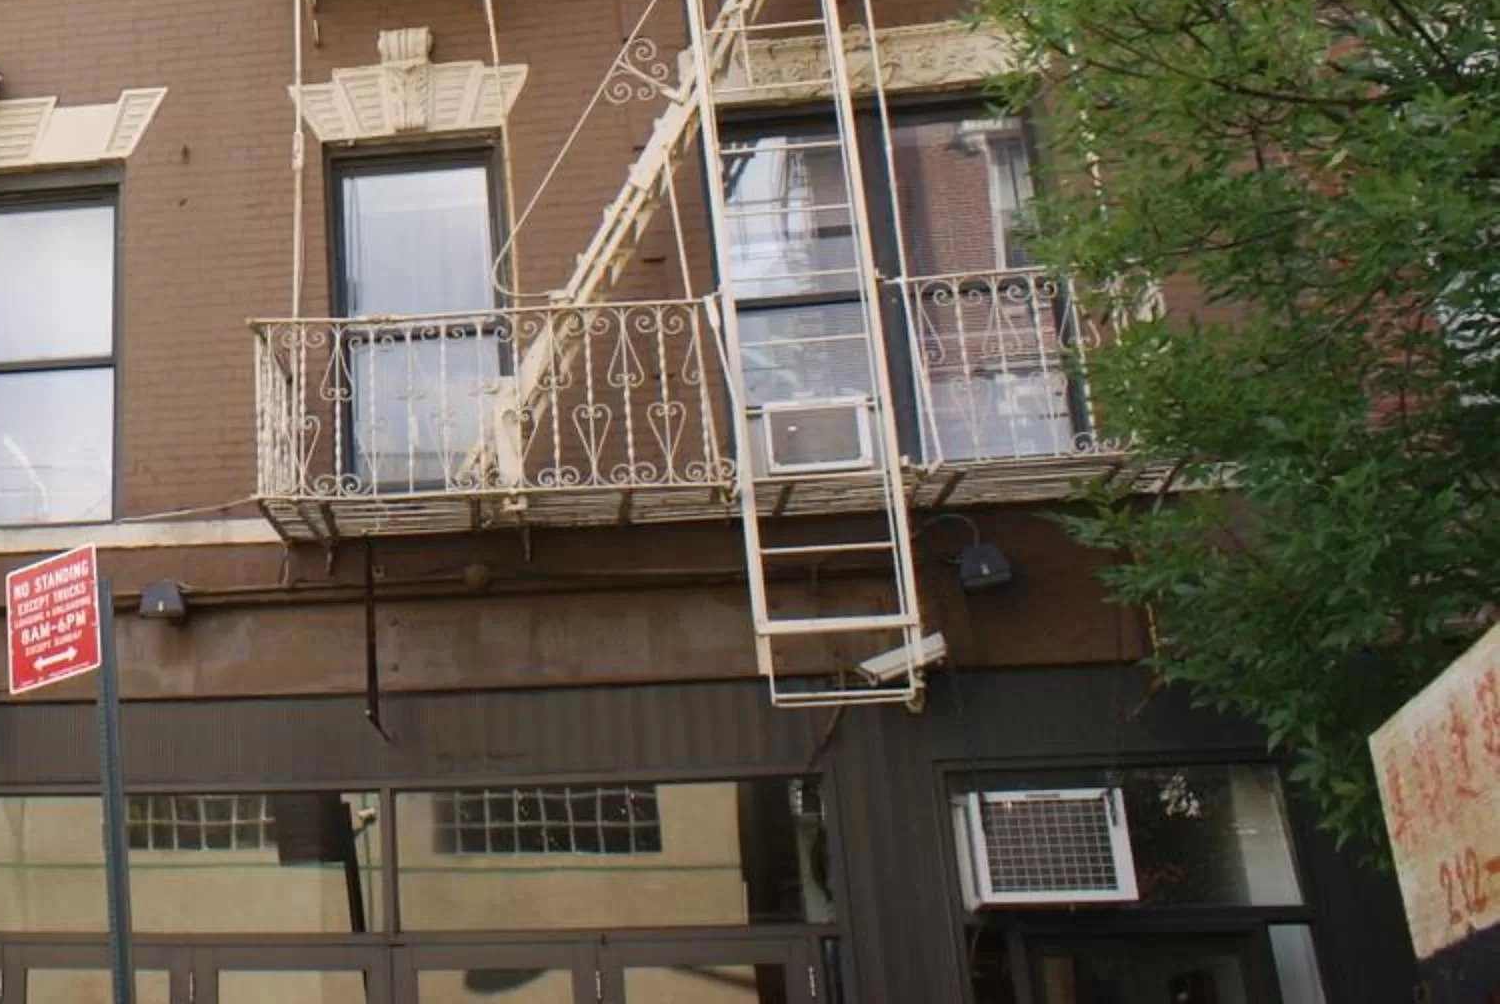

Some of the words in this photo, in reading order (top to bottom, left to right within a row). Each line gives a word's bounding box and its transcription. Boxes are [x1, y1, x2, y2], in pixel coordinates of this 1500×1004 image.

[13, 581, 29, 600] NO
[34, 560, 89, 593] STANDING
[17, 595, 50, 616] EXCEPT
[53, 582, 86, 605] TRUCKS
[21, 610, 87, 645] 8AM-6PM
